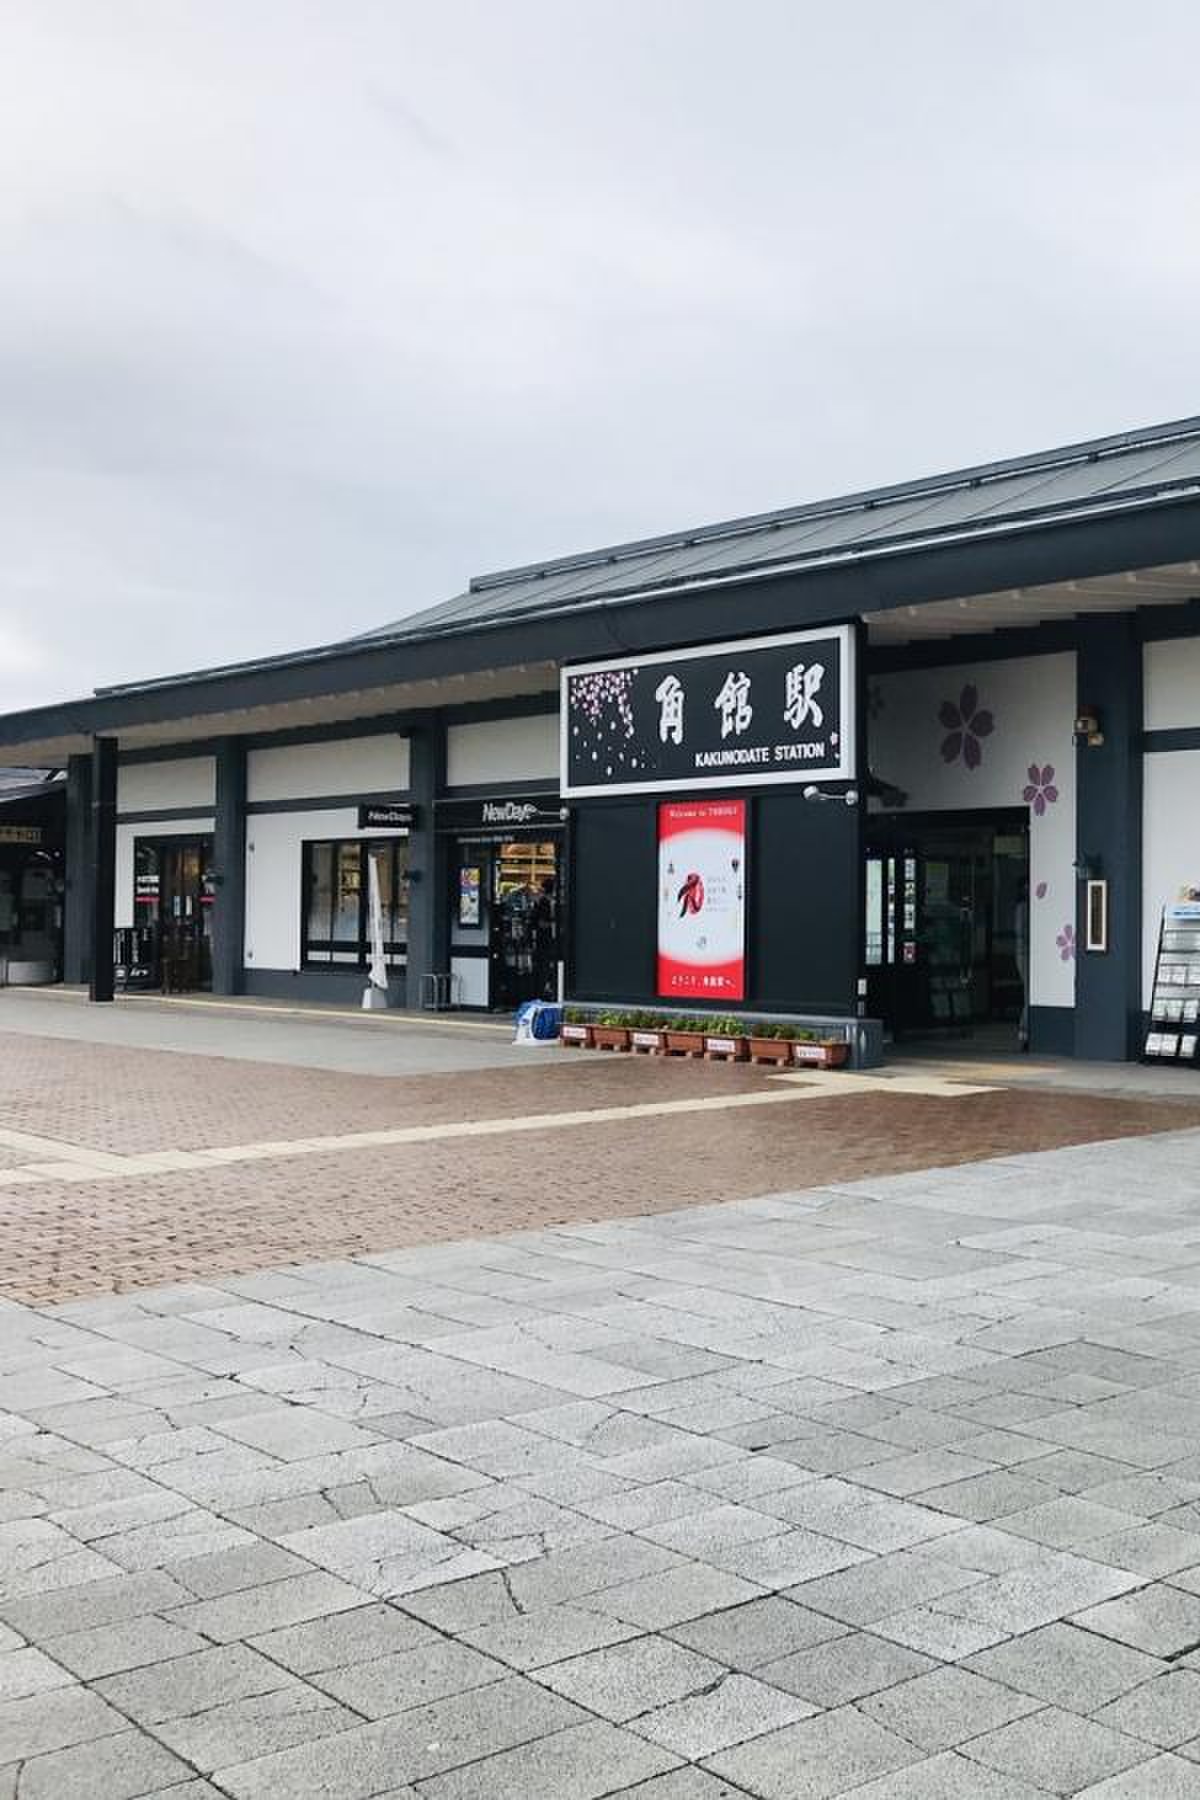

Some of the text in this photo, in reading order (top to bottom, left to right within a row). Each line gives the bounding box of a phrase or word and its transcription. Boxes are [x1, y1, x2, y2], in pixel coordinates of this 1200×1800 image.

[655, 663, 825, 745] 角館駅
[695, 742, 825, 767] KAKUNODATE STATION
